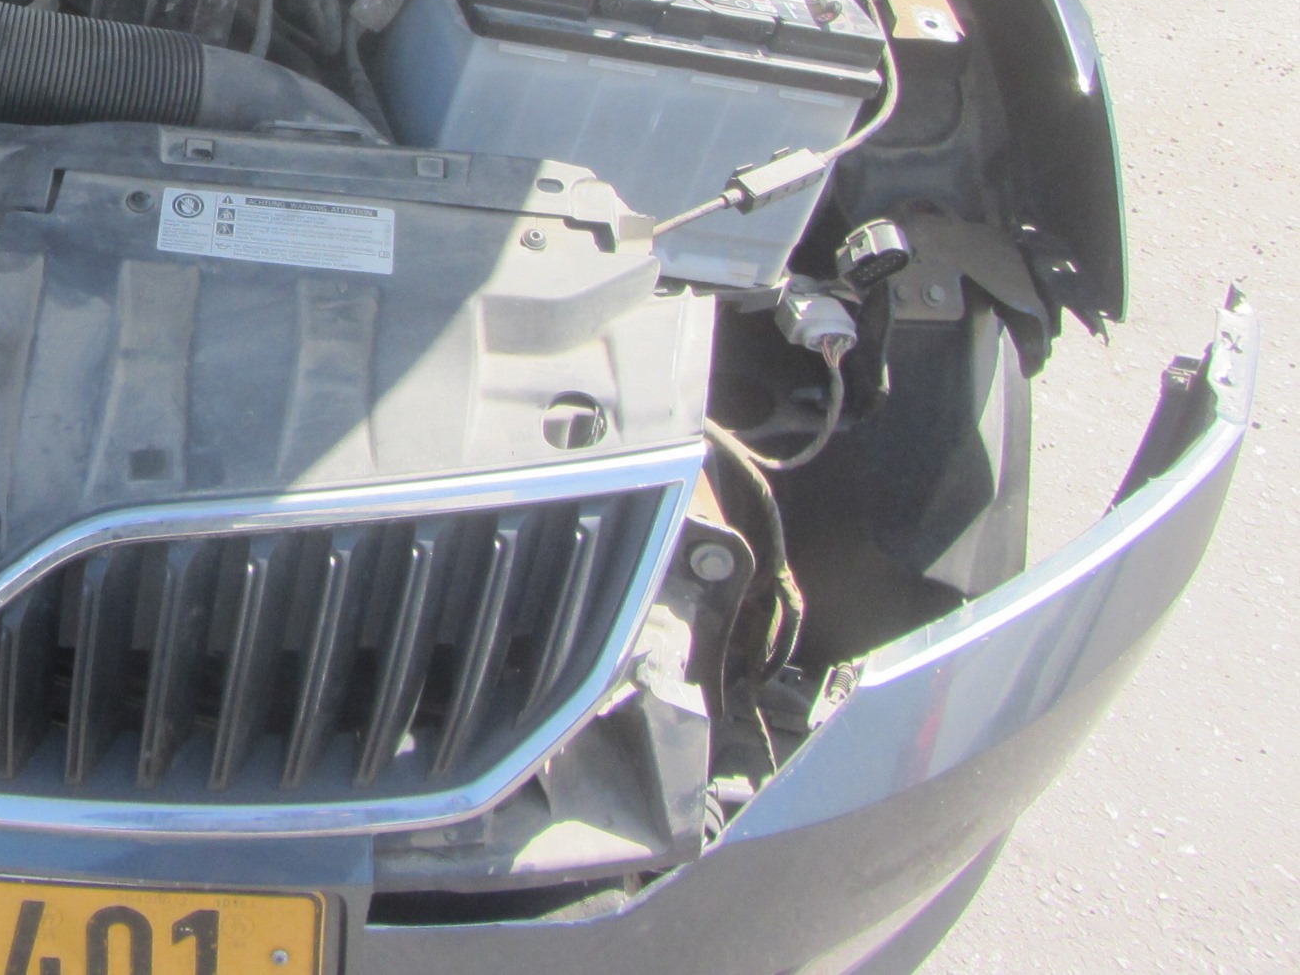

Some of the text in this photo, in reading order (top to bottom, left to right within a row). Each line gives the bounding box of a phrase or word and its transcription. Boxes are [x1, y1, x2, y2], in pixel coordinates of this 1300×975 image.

[248, 199, 374, 217] ACHTUNG WARNING ATTENTION
